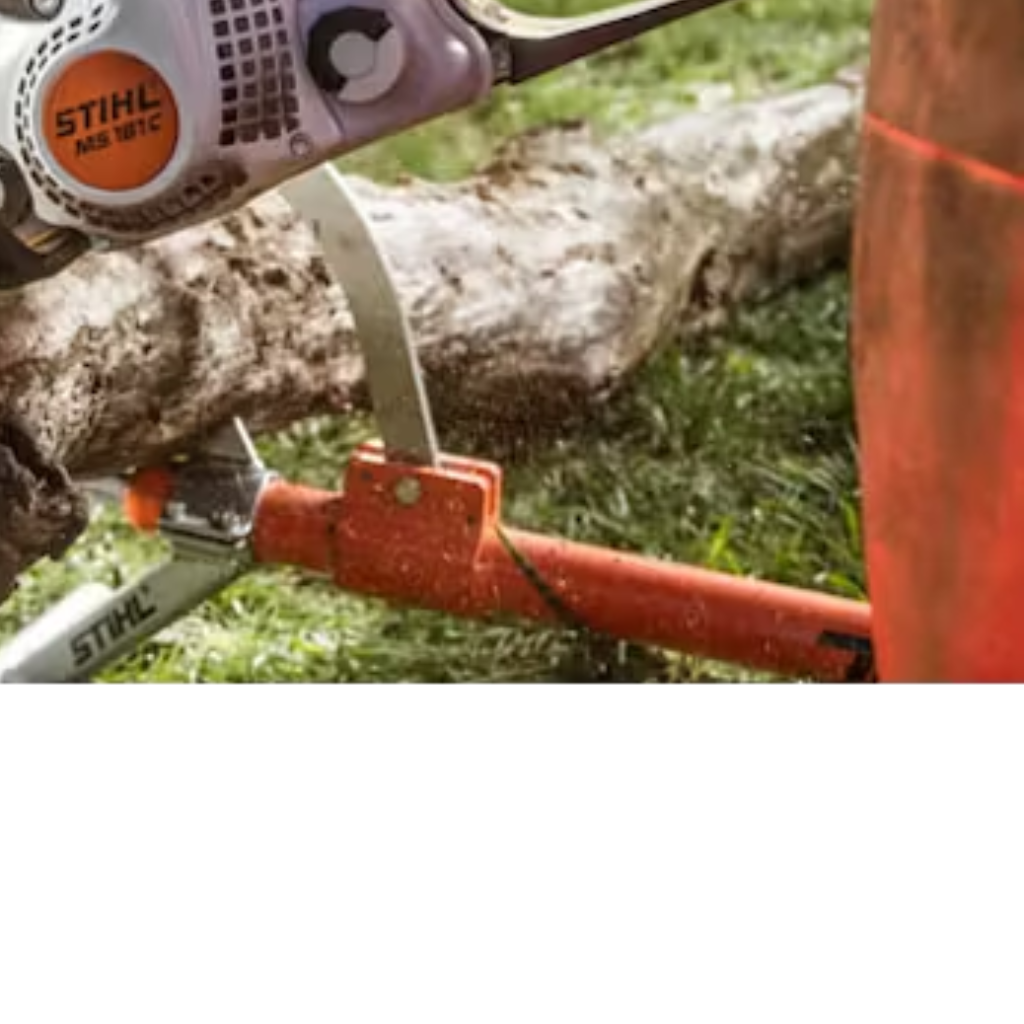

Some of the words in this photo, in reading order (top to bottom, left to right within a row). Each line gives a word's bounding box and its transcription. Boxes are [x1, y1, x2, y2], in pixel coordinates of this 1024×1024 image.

[56, 83, 161, 137] STIHL
[75, 130, 111, 157] MS
[71, 594, 156, 666] STIHL
